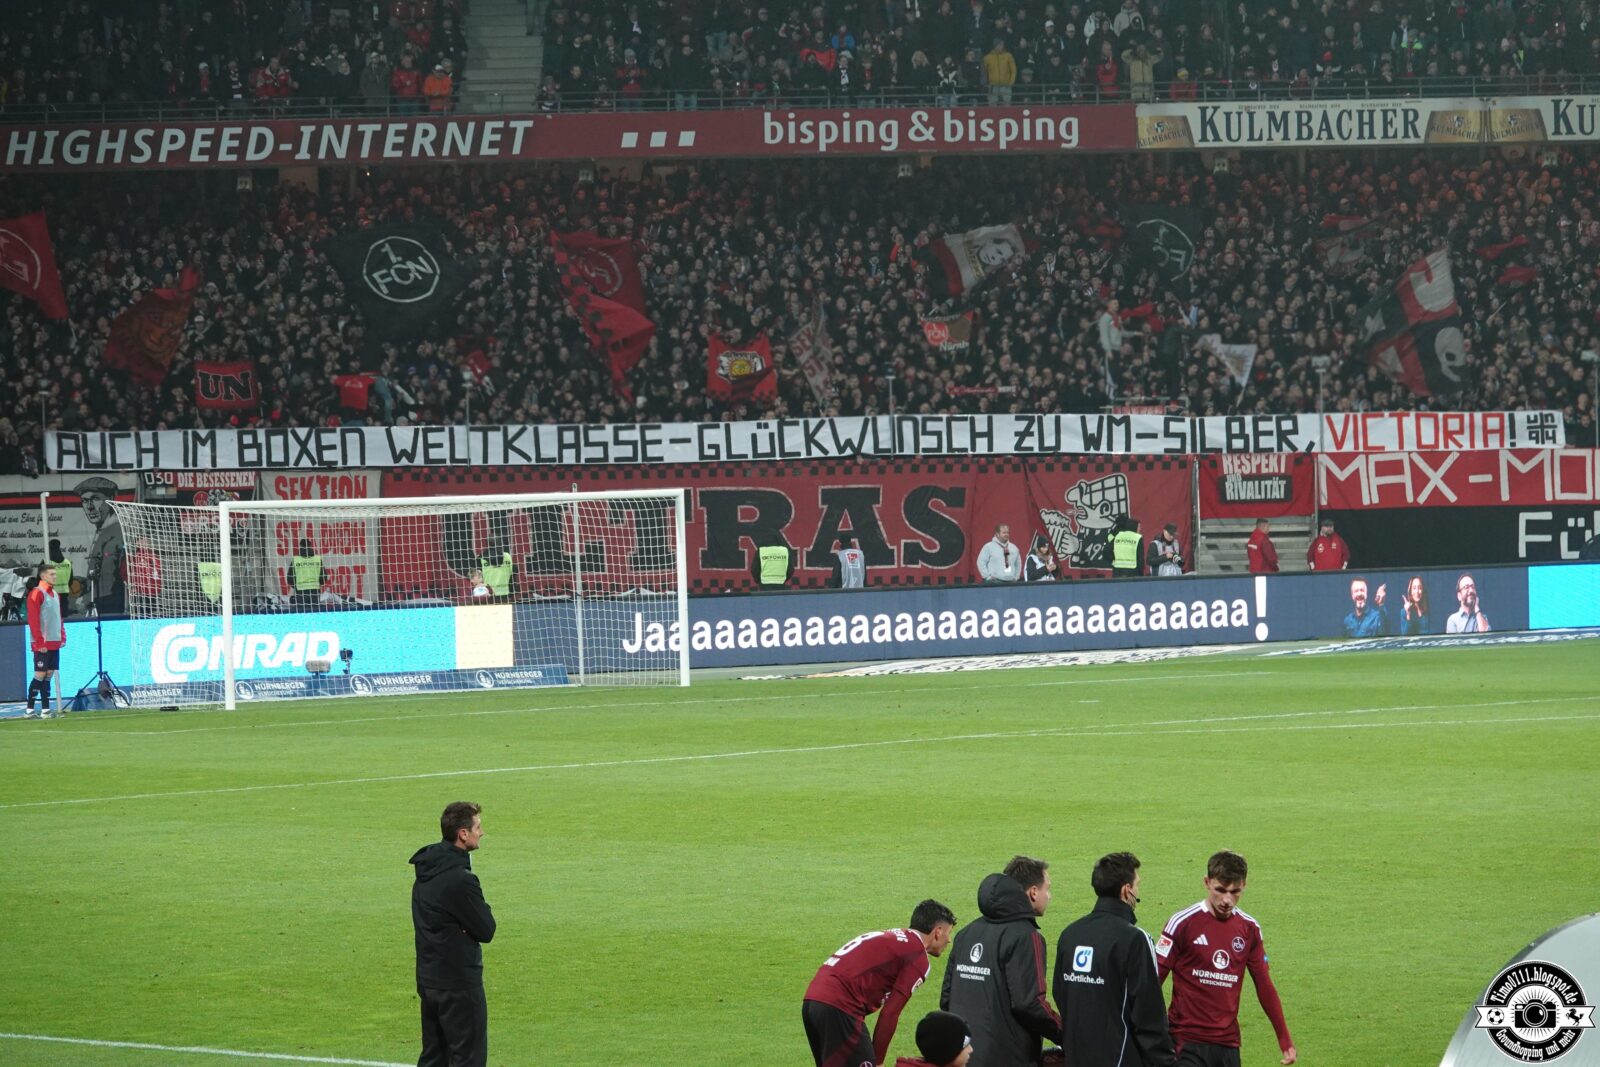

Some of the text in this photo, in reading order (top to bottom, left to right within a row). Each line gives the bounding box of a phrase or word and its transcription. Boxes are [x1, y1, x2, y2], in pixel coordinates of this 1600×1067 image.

[763, 109, 1080, 152] bisping & bisping
[1198, 105, 1421, 143] KULMBACHER
[1551, 99, 1600, 137] KU
[4, 120, 534, 165] HIGHSPEED-INTERNET
[372, 256, 434, 295] FCN
[197, 369, 253, 401] UN
[57, 431, 160, 469] AUCH
[182, 430, 217, 469] IM
[238, 427, 365, 468] BOXEN
[1014, 414, 1060, 453] ZU
[1325, 411, 1516, 451] VICTORIA!
[144, 472, 173, 486] 030
[177, 471, 255, 488] DIE BESESSENEN
[1223, 454, 1287, 475] RESPEKT
[1318, 449, 1600, 505] MAX-MO
[275, 475, 367, 500] SEKTION
[1225, 477, 1287, 501] RIVALITÄT
[276, 521, 366, 556] STADION
[1518, 511, 1600, 559] FÜ
[278, 565, 366, 599] VBOT
[150, 623, 341, 683] CONRAD
[373, 674, 432, 686] NÜRNBERGER
[494, 670, 544, 679] NÜRNBERGER
[956, 964, 991, 976] NÜRNBERGER
[1192, 969, 1239, 983] NÜRNBERGER
[1200, 978, 1233, 988] VERSICHERUNG
